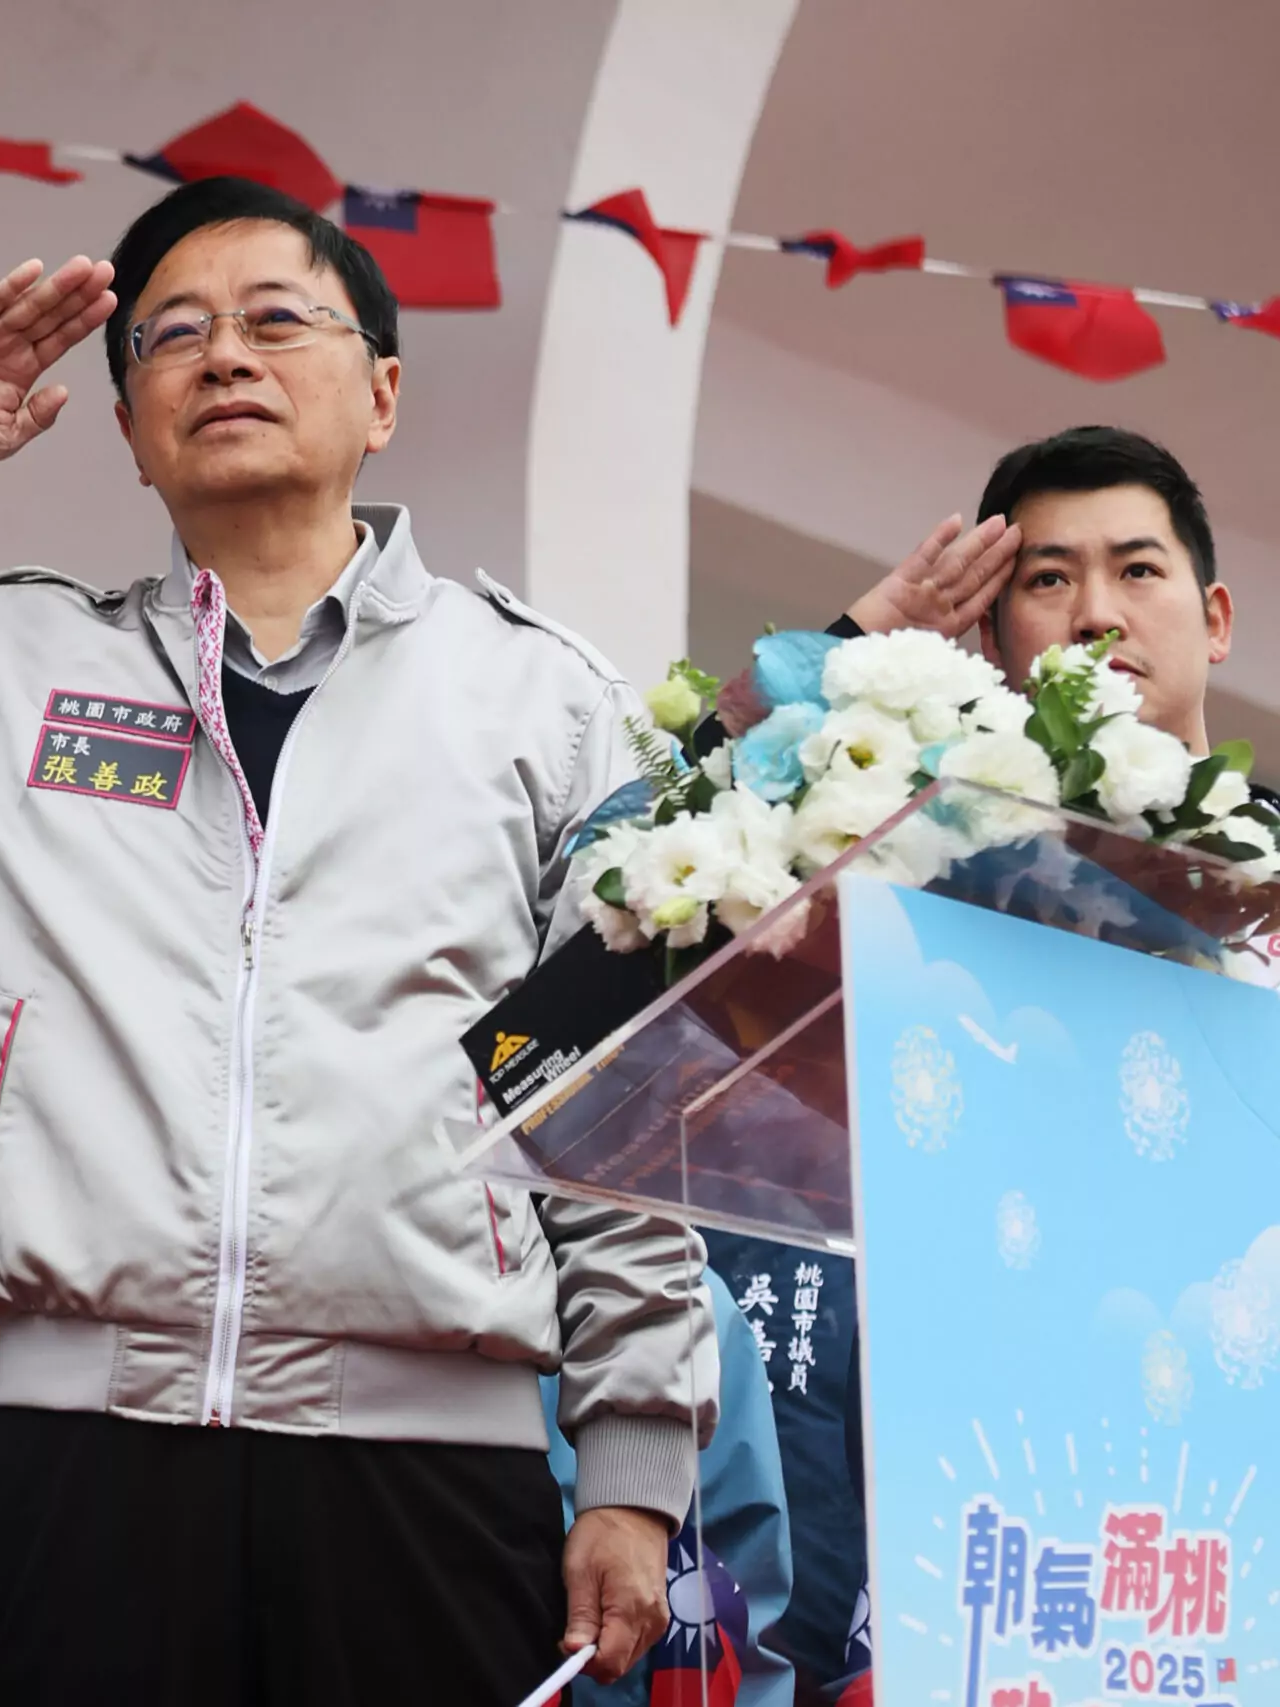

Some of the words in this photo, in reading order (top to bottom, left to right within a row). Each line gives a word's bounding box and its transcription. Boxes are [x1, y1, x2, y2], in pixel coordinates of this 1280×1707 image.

[58, 697, 183, 733] 桃園市政府
[50, 732, 92, 756] 市長
[41, 754, 169, 801] 張善政
[489, 1068, 505, 1085] TOP
[504, 1038, 540, 1073] MEASURE
[502, 1049, 564, 1105] Measuring
[541, 1045, 581, 1083] Wheel
[787, 1262, 824, 1395] 桃園市議員
[1104, 1648, 1205, 1698] 2025
